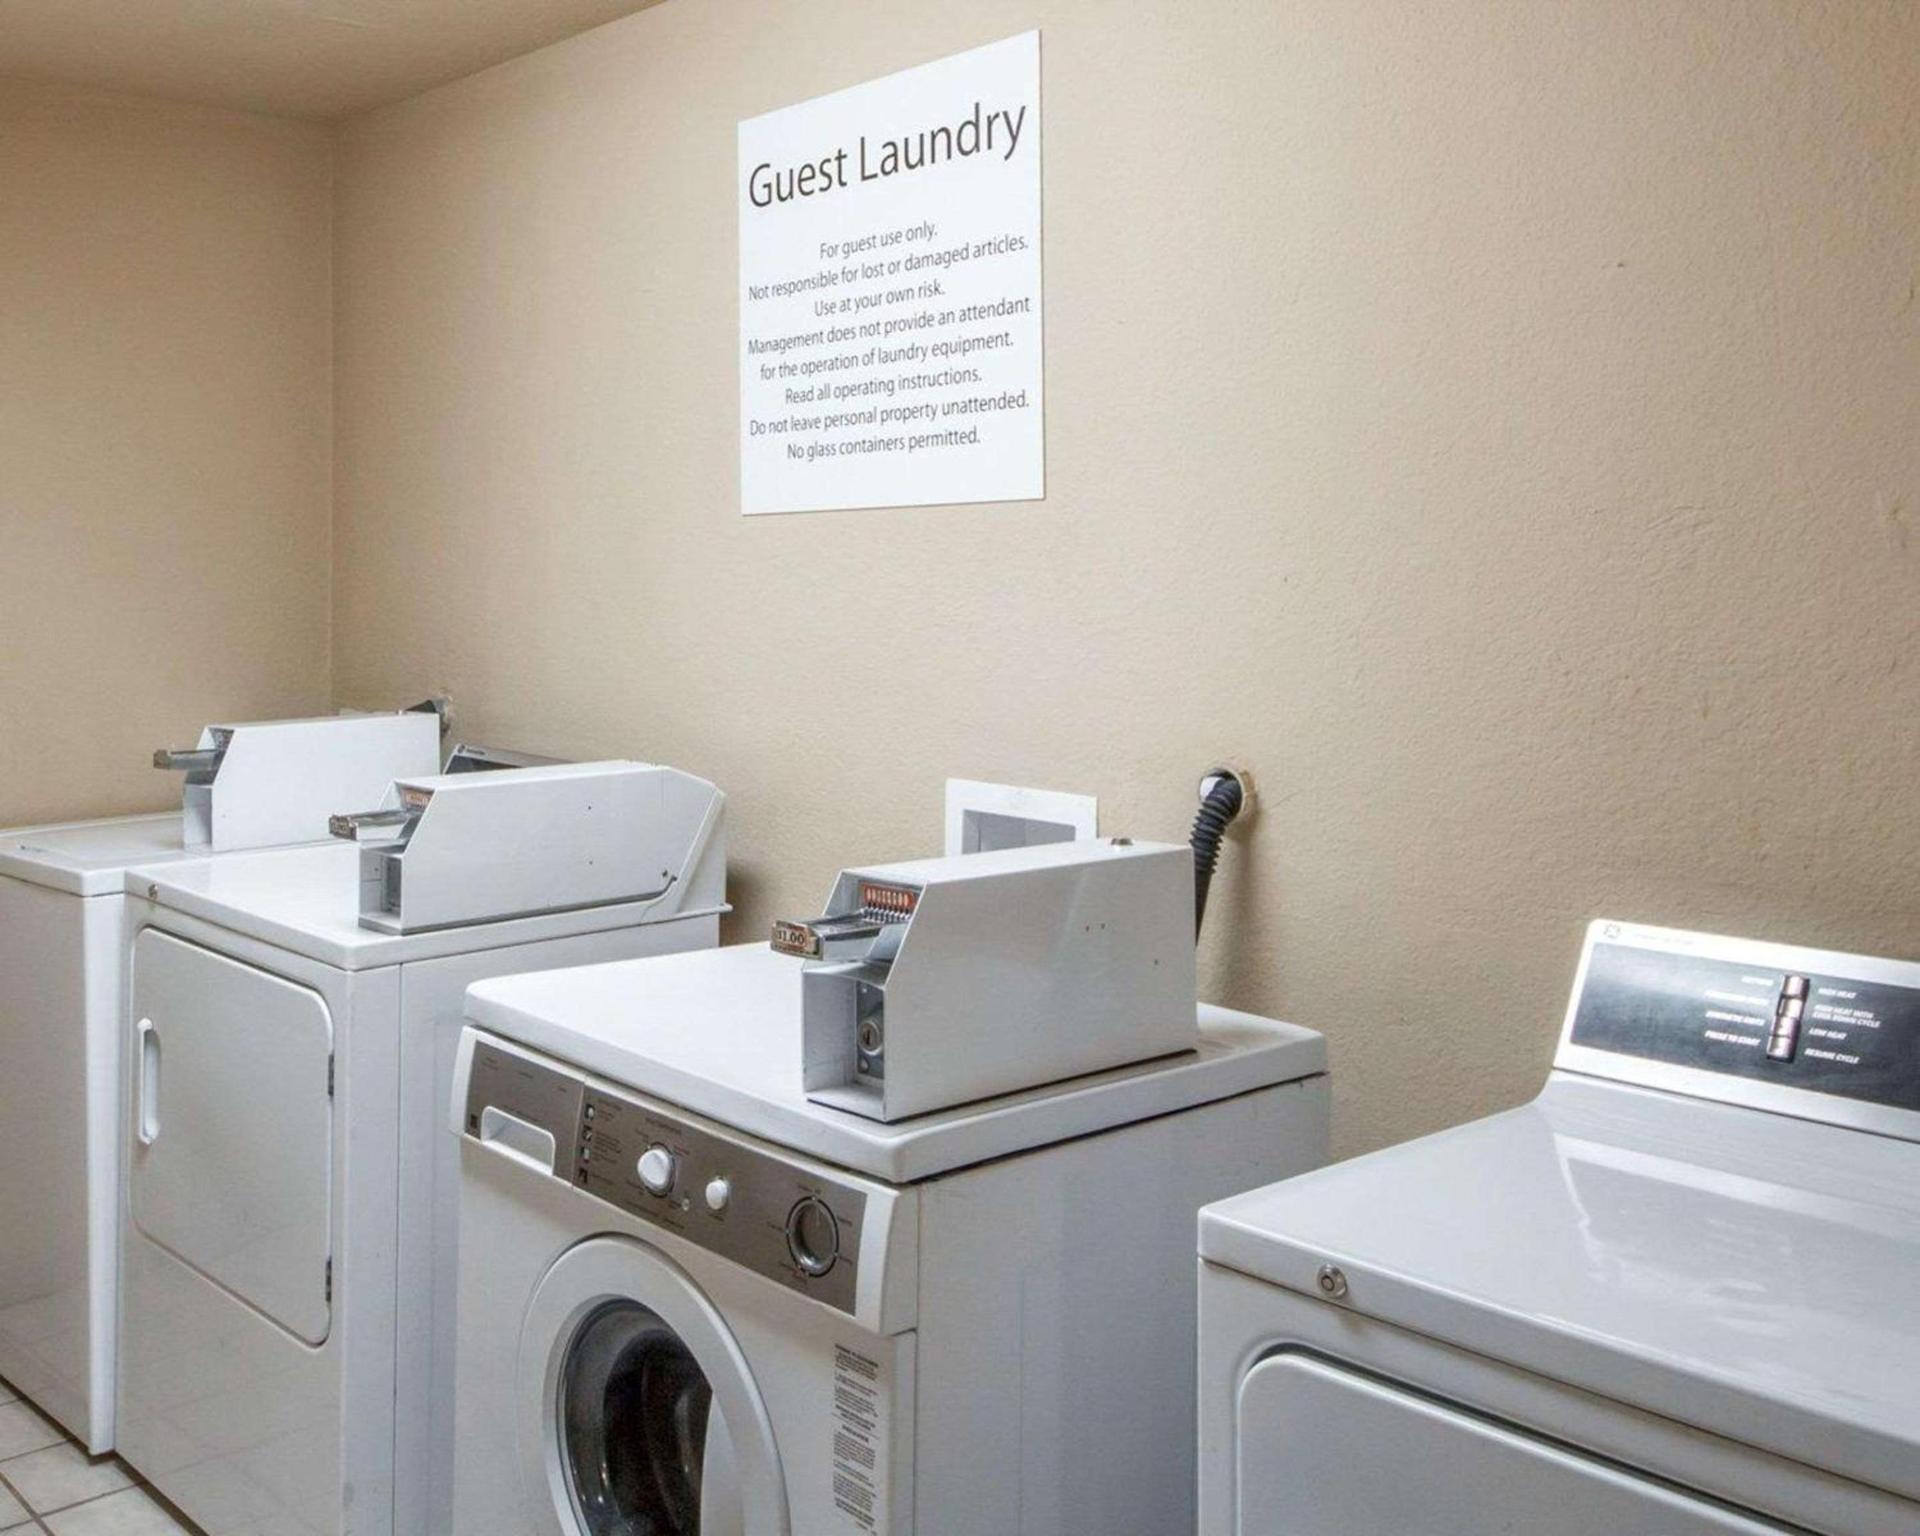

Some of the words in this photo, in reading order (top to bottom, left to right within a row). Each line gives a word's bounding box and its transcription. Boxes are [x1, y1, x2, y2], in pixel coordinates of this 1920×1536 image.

[749, 148, 847, 208] Guest
[860, 101, 1026, 182] Laundry
[820, 242, 840, 259] For
[842, 235, 876, 259] guest
[880, 231, 903, 247] use
[905, 220, 938, 242] only.
[749, 285, 769, 301] Not
[772, 270, 838, 297] responsible
[842, 265, 858, 283] for
[861, 262, 885, 279] lost
[888, 260, 901, 275] or
[904, 241, 970, 269] damaged
[973, 234, 1029, 258] articles.
[814, 300, 836, 317] Use
[839, 298, 851, 312] at
[854, 293, 882, 314] your
[886, 286, 914, 304] own
[918, 278, 946, 298] risk.
[749, 331, 824, 355] Management
[826, 326, 856, 343] does
[860, 321, 881, 337] not
[884, 312, 935, 338] provide
[938, 311, 955, 325] an
[959, 297, 1030, 323] attendant
[760, 363, 775, 380] for
[779, 360, 798, 378] the
[800, 353, 858, 377] operation
[862, 348, 876, 366] of
[878, 343, 928, 364] laundry
[931, 331, 1014, 359] equipment.
[785, 386, 814, 404] Read
[817, 383, 831, 401] all
[833, 377, 895, 401] operating
[898, 368, 983, 391] instructions.
[750, 419, 766, 436] Do
[769, 419, 788, 433] not
[790, 415, 822, 432] leave
[824, 406, 877, 431] personal
[880, 403, 938, 425] property
[942, 389, 1030, 417] unattended.
[787, 443, 805, 460] No
[807, 441, 837, 462] glass
[839, 436, 905, 456] containers
[908, 425, 981, 453] permitted.
